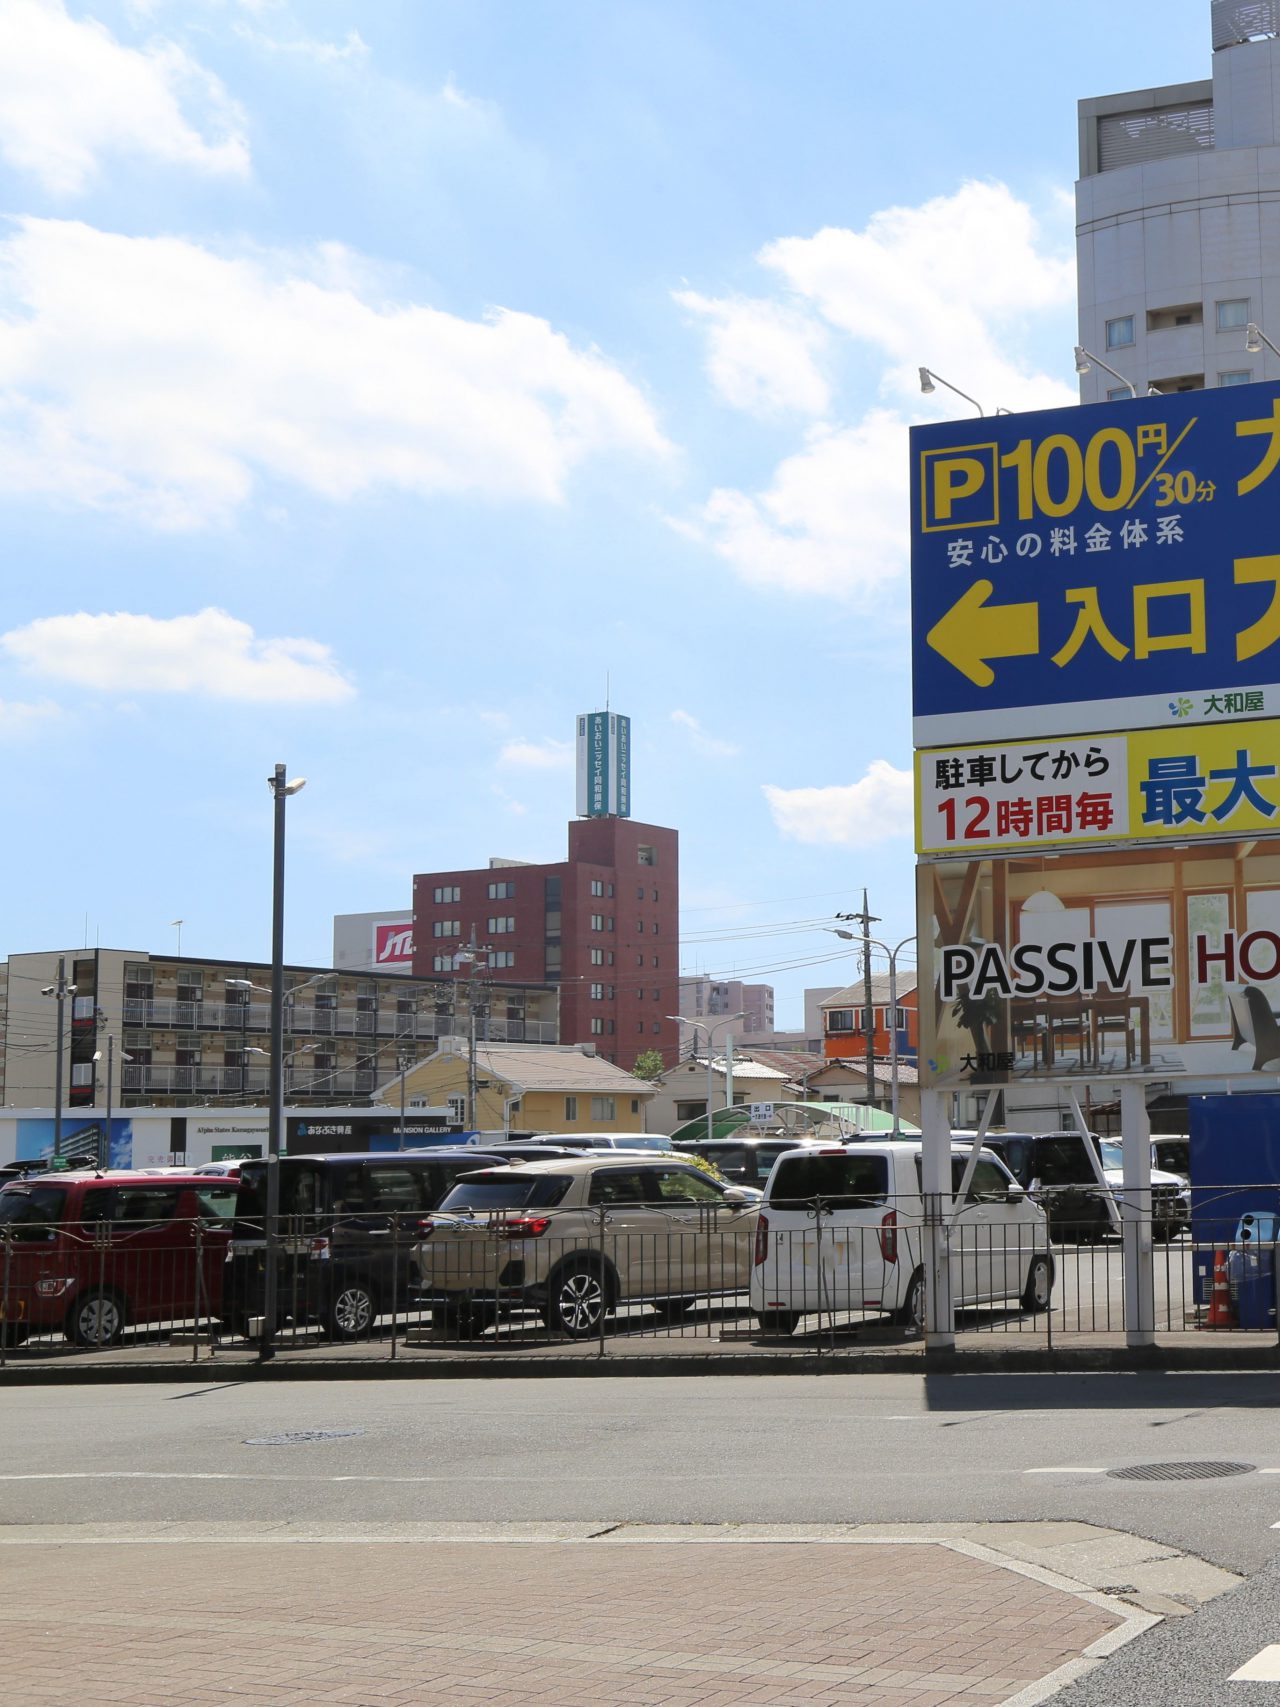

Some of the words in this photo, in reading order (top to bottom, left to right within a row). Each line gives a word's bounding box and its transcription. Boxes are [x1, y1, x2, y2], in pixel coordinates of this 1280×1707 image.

[934, 457, 985, 520] P
[946, 514, 1185, 568] 安心の料金体系
[1051, 579, 1207, 667] 入口
[1203, 691, 1265, 716] 大和屋
[935, 747, 1110, 790] 駐車してから
[937, 791, 1114, 840] 12時間毎
[942, 936, 1171, 998] PASSIVE
[960, 1052, 1014, 1073] 大和屋
